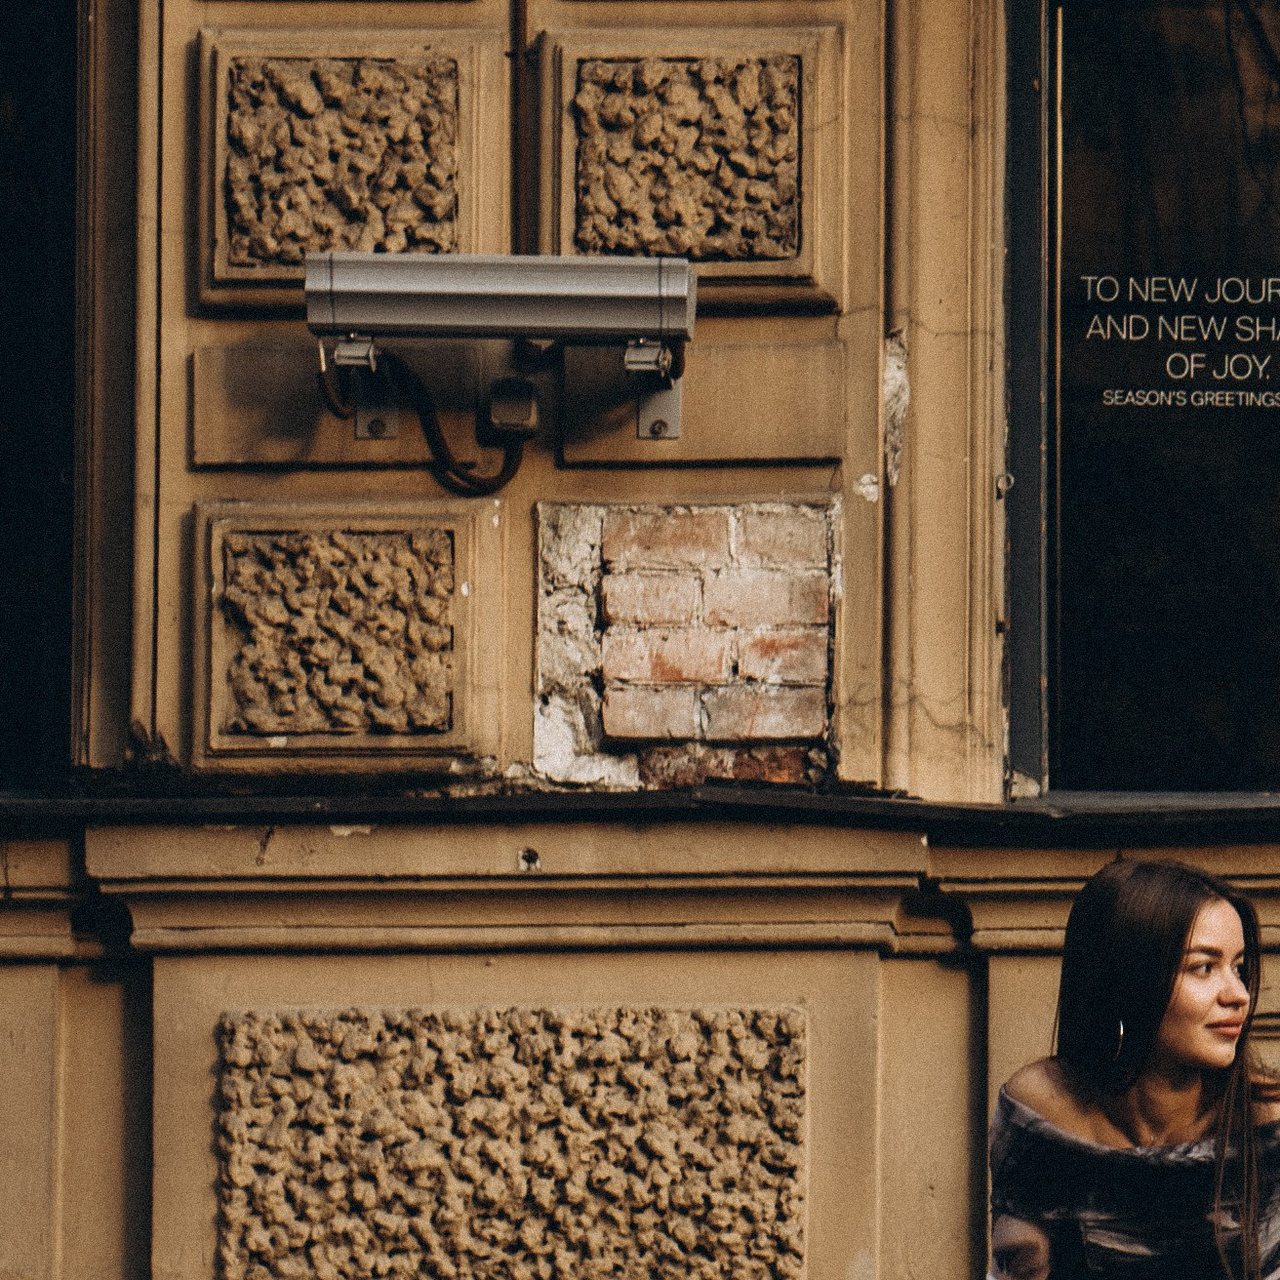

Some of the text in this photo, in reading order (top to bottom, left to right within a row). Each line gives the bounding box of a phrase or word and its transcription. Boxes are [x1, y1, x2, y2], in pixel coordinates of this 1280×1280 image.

[1080, 275, 1119, 302] TO
[1128, 276, 1198, 303] NEW
[1085, 314, 1150, 341] AND
[1158, 315, 1228, 342] NEW
[1165, 352, 1272, 381] OF JOY.
[1102, 389, 1187, 406] SEASON'S
